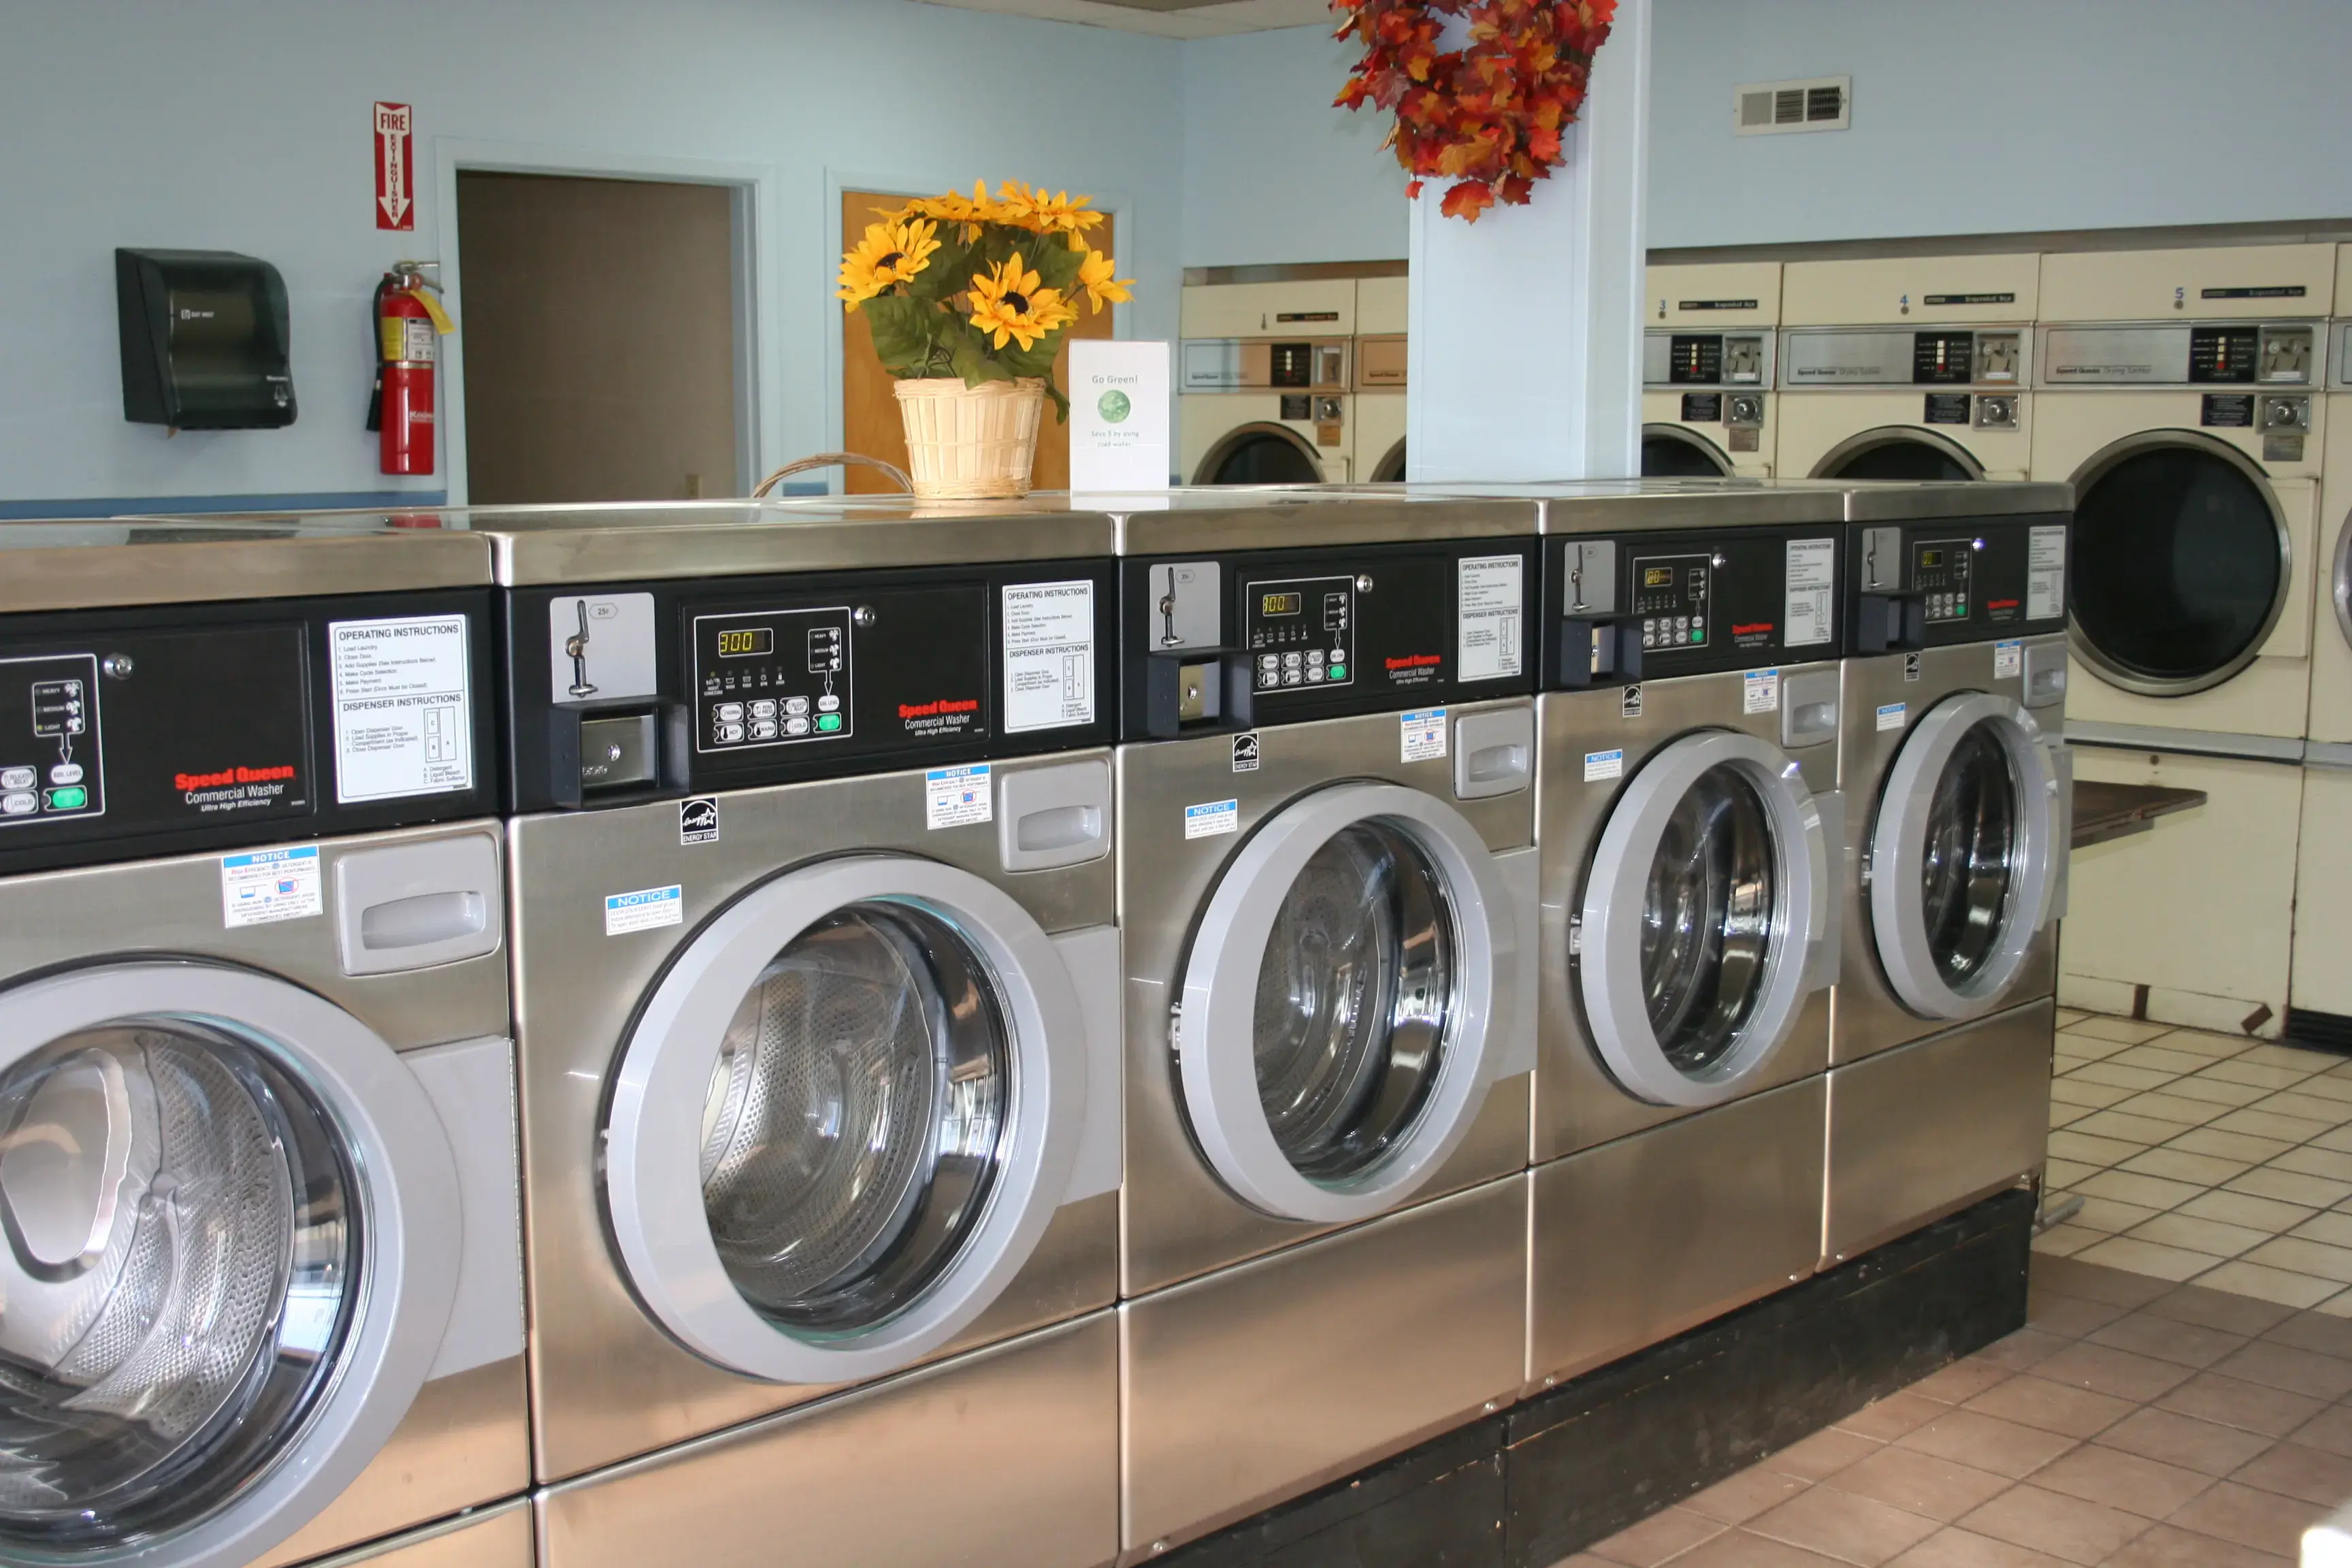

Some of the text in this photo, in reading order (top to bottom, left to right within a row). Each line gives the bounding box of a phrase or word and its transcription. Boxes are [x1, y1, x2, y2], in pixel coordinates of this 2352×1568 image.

[380, 114, 406, 131] FIRE
[1900, 294, 1908, 305] 4
[2175, 288, 2183, 299] 5
[1660, 299, 1665, 309] 3
[1092, 375, 1138, 384] Go Green!
[1463, 561, 1518, 571] OPERATING INSTRUCTIONS
[1008, 588, 1088, 600] OPERATING INSTRUCTIONS
[339, 624, 459, 641] OPERATING INSTRUCTIONS
[1010, 644, 1088, 658] DISPENSER INSTRUCTIONS
[1385, 656, 1412, 669] Speed
[1390, 666, 1435, 679] Commercial Washer
[343, 694, 461, 711] DISPENSER INSTRUCTIONS
[898, 700, 977, 719] Speed Queen
[905, 714, 970, 730] Commercial Washer
[1591, 753, 1617, 762] NOTICE
[175, 765, 294, 791] Speed Queen
[946, 768, 971, 777] NOTICE
[185, 783, 284, 805] Commercial Washer
[201, 798, 272, 813] Ultra High Efficiency
[1194, 803, 1230, 816] NOTICE
[683, 834, 702, 842] ENERGY
[252, 851, 290, 863] NOTICE
[618, 890, 670, 906] NOTICE
